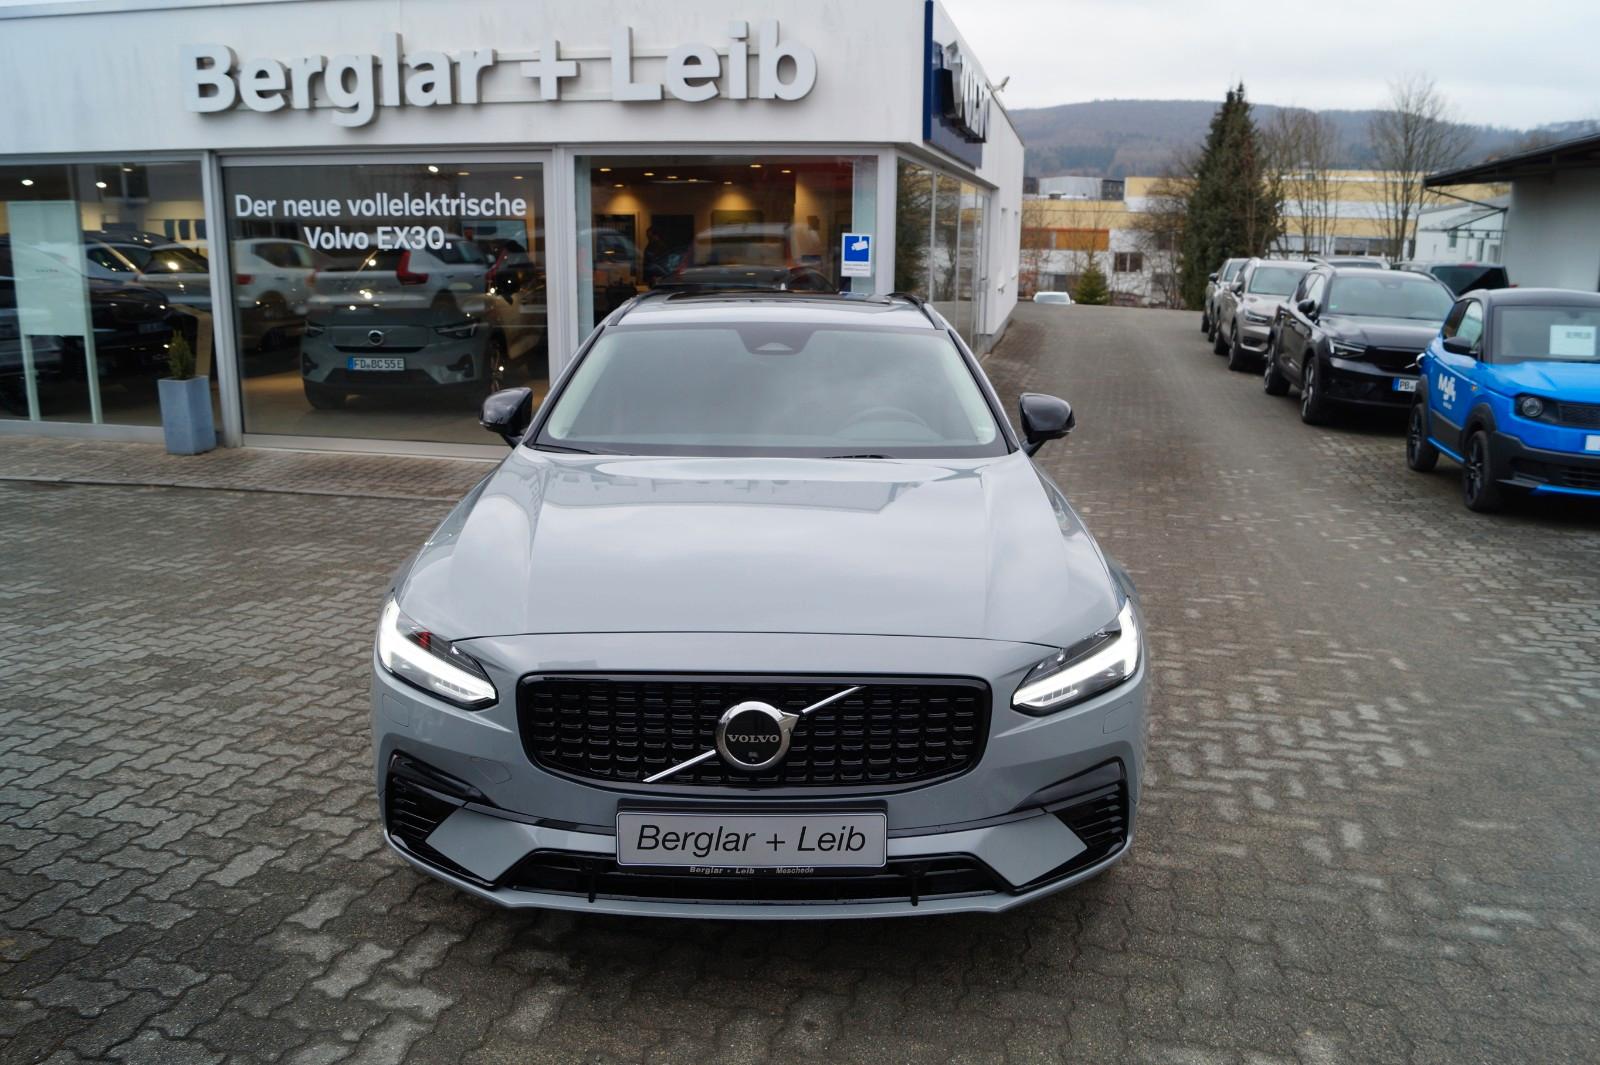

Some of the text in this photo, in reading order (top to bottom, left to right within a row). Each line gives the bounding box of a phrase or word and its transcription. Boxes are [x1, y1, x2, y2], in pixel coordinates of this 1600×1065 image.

[182, 19, 818, 127] Berglar + Leib
[235, 192, 527, 217] Der neue vollelektrische
[304, 226, 452, 250] Volvo EX30.
[727, 734, 780, 743] VOLVO
[636, 824, 866, 858] Berglar + Leib
[689, 866, 723, 875] Berglar
[735, 867, 755, 875] Leib
